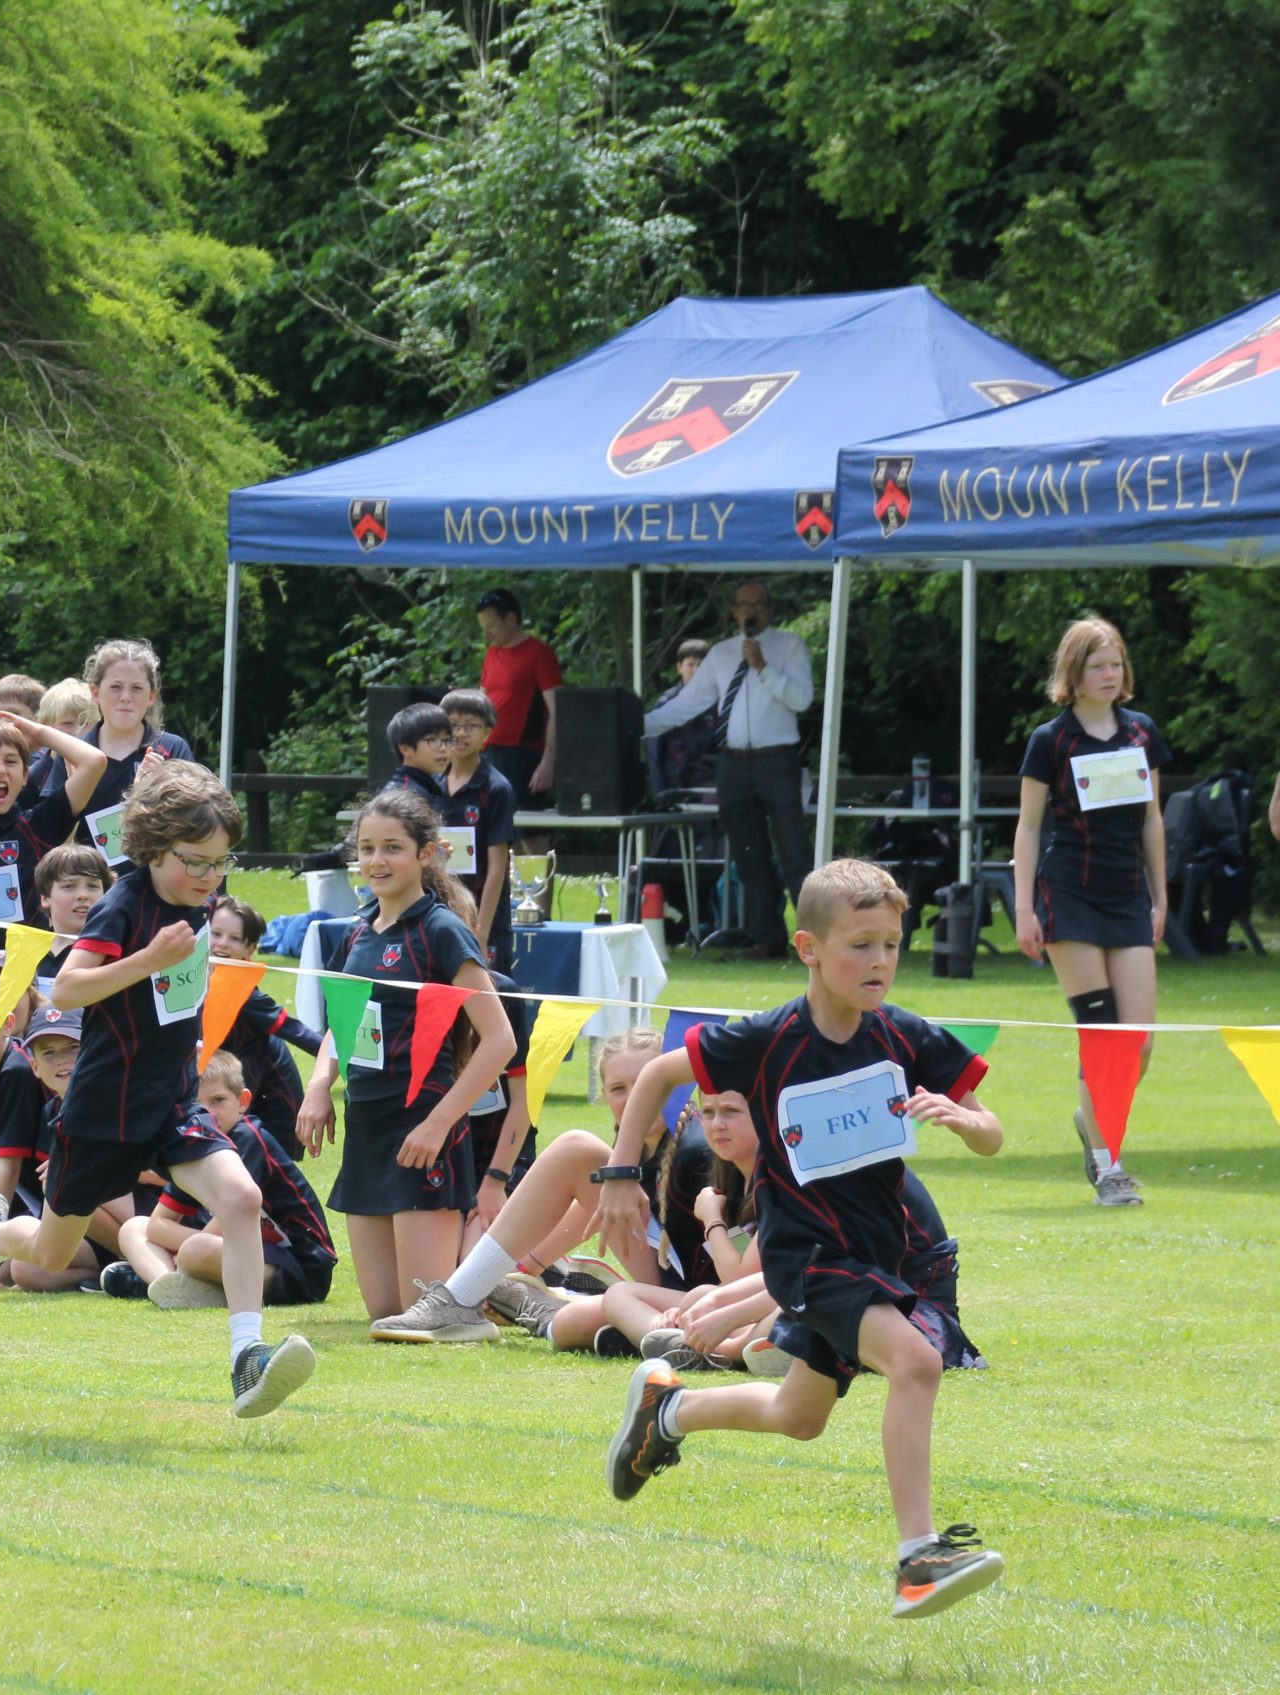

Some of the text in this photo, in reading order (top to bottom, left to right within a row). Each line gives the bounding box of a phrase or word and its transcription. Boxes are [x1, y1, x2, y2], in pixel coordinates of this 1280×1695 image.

[938, 448, 1252, 522] MOUNT KELLY
[443, 502, 736, 545] MOUNT KELLY
[825, 1106, 872, 1136] FRY
